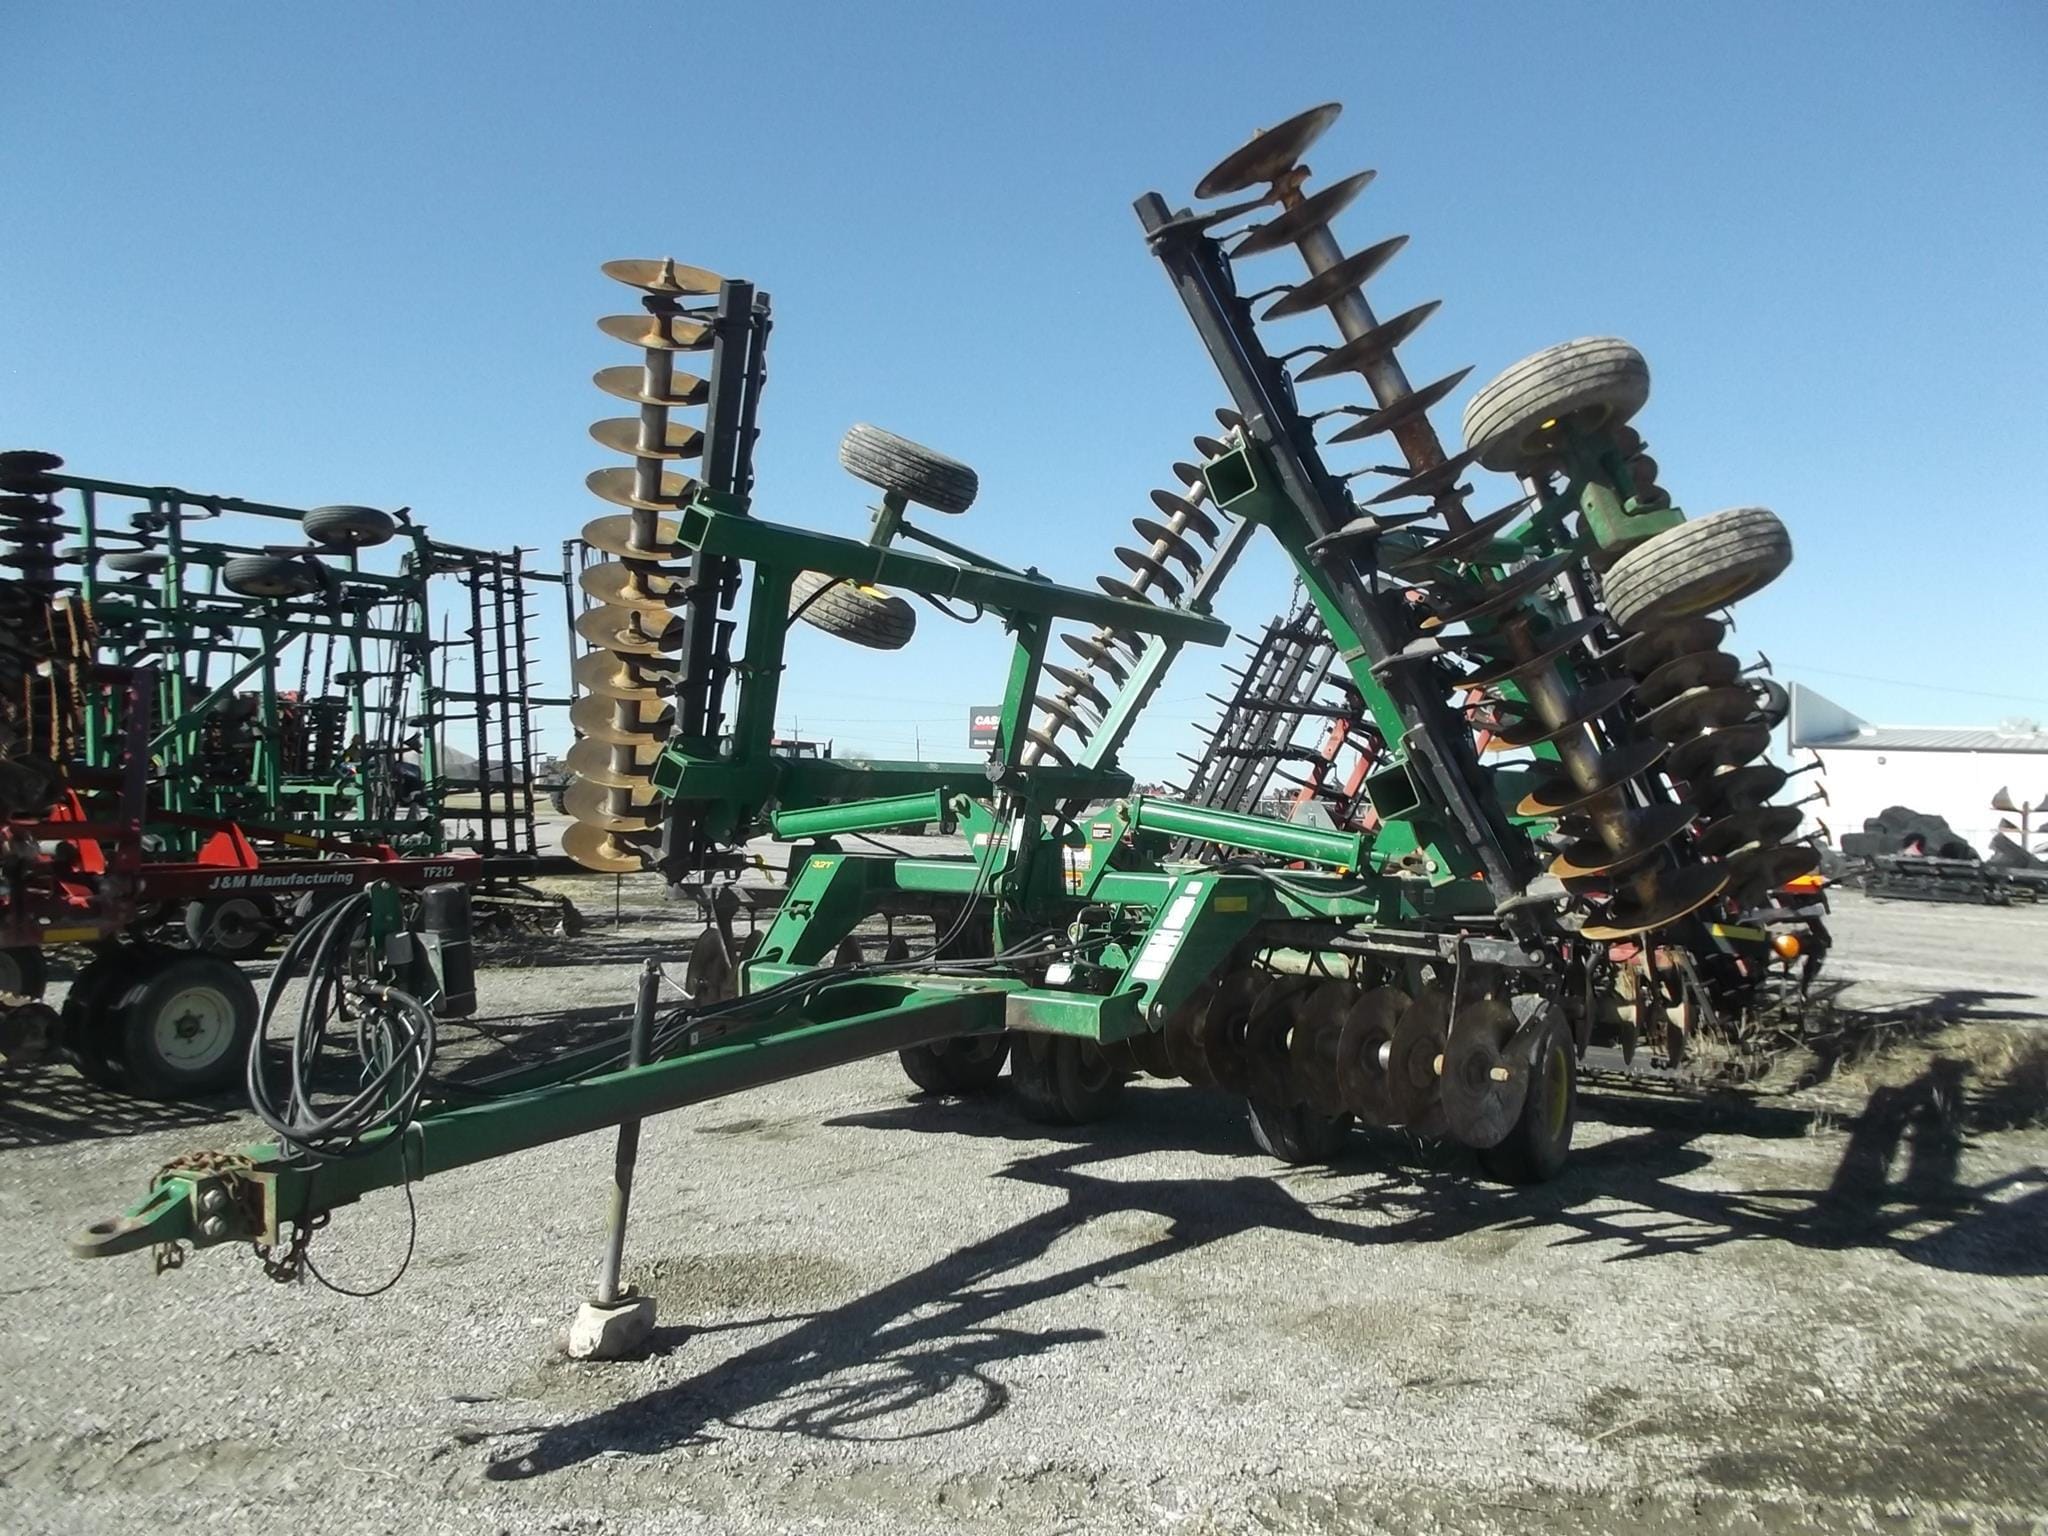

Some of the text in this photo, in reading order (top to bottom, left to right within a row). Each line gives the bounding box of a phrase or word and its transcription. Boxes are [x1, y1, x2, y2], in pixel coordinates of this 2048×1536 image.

[423, 865, 455, 878] TF212
[209, 871, 354, 890] J&M Manufacturing
